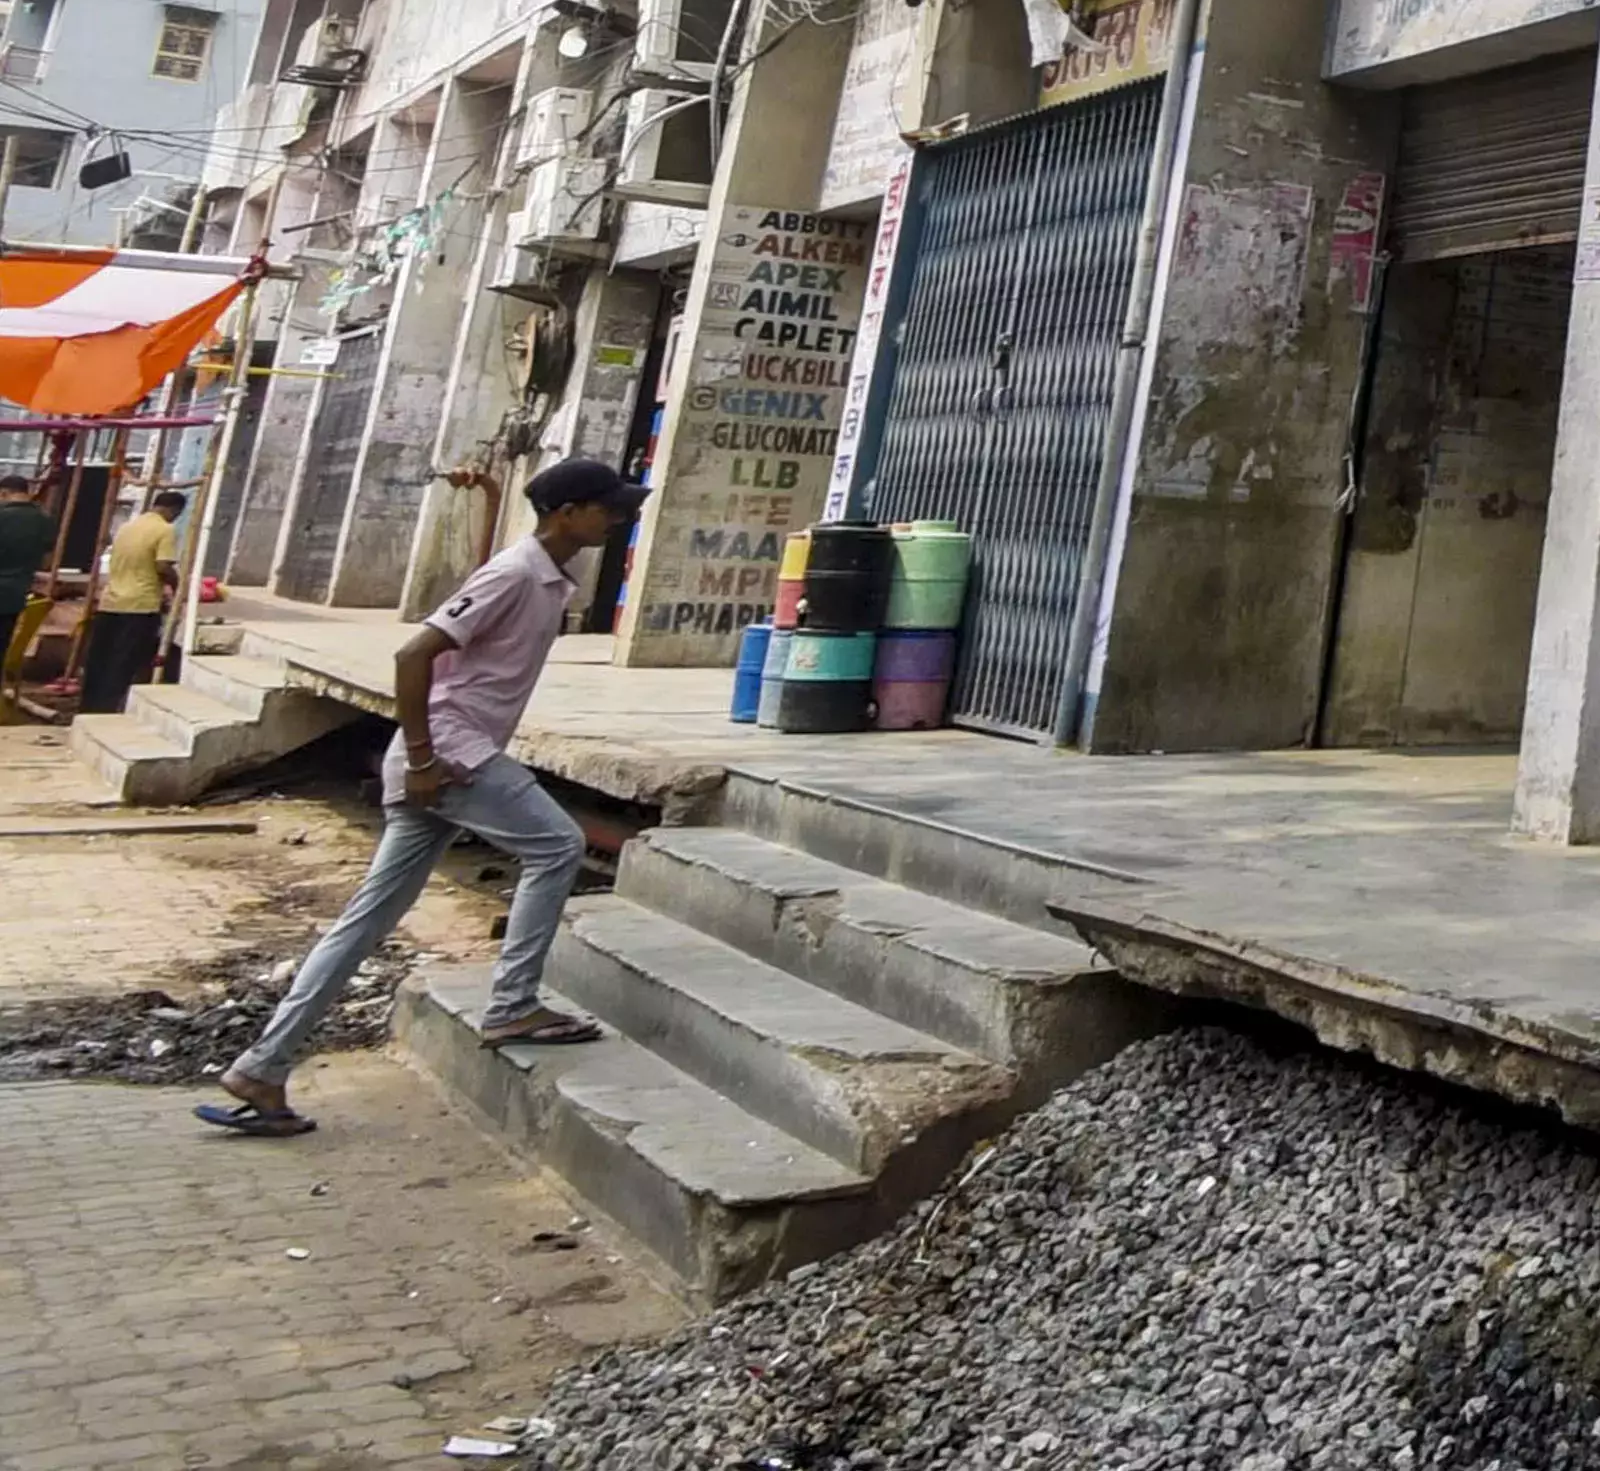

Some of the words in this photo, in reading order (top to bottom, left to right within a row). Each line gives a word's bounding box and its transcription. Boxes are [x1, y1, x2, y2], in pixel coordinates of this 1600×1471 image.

[758, 211, 869, 240] ABBOTT
[753, 234, 868, 267] ALKEM
[747, 261, 848, 293] APEX
[740, 288, 839, 322] AIMIL
[719, 387, 830, 422] GENIX
